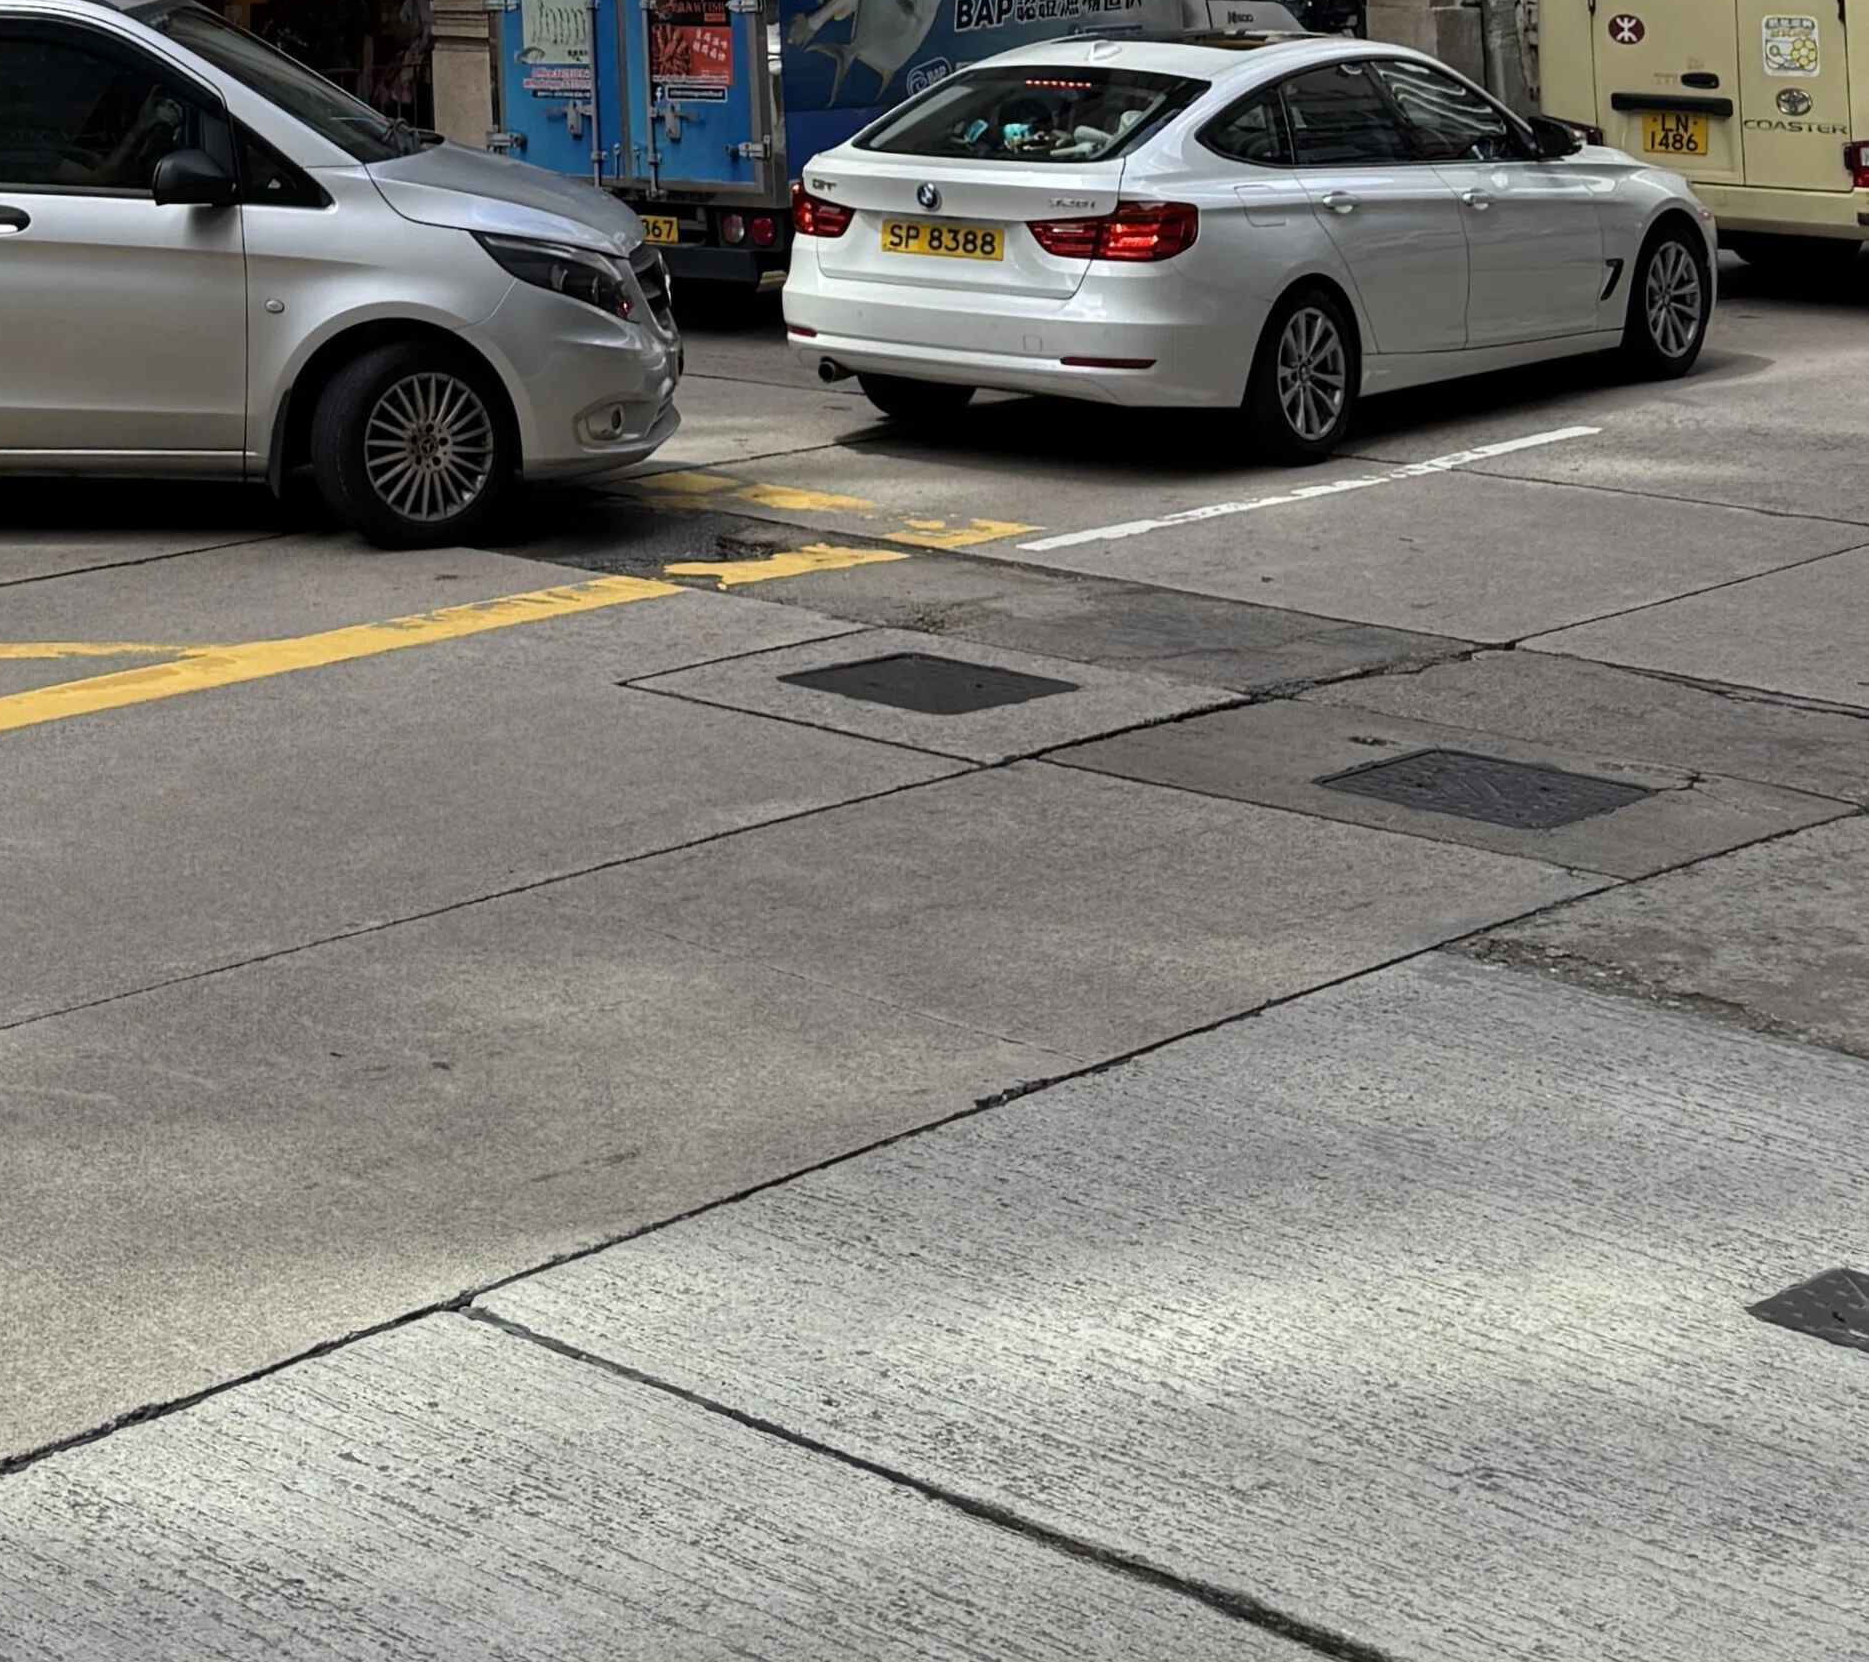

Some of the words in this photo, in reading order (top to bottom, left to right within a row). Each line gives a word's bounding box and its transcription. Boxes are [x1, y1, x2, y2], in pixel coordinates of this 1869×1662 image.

[1661, 113, 1689, 133] LN
[1743, 119, 1848, 135] COASTER
[1650, 132, 1699, 153] 1486
[888, 223, 921, 250] SP
[928, 227, 997, 255] 8388
